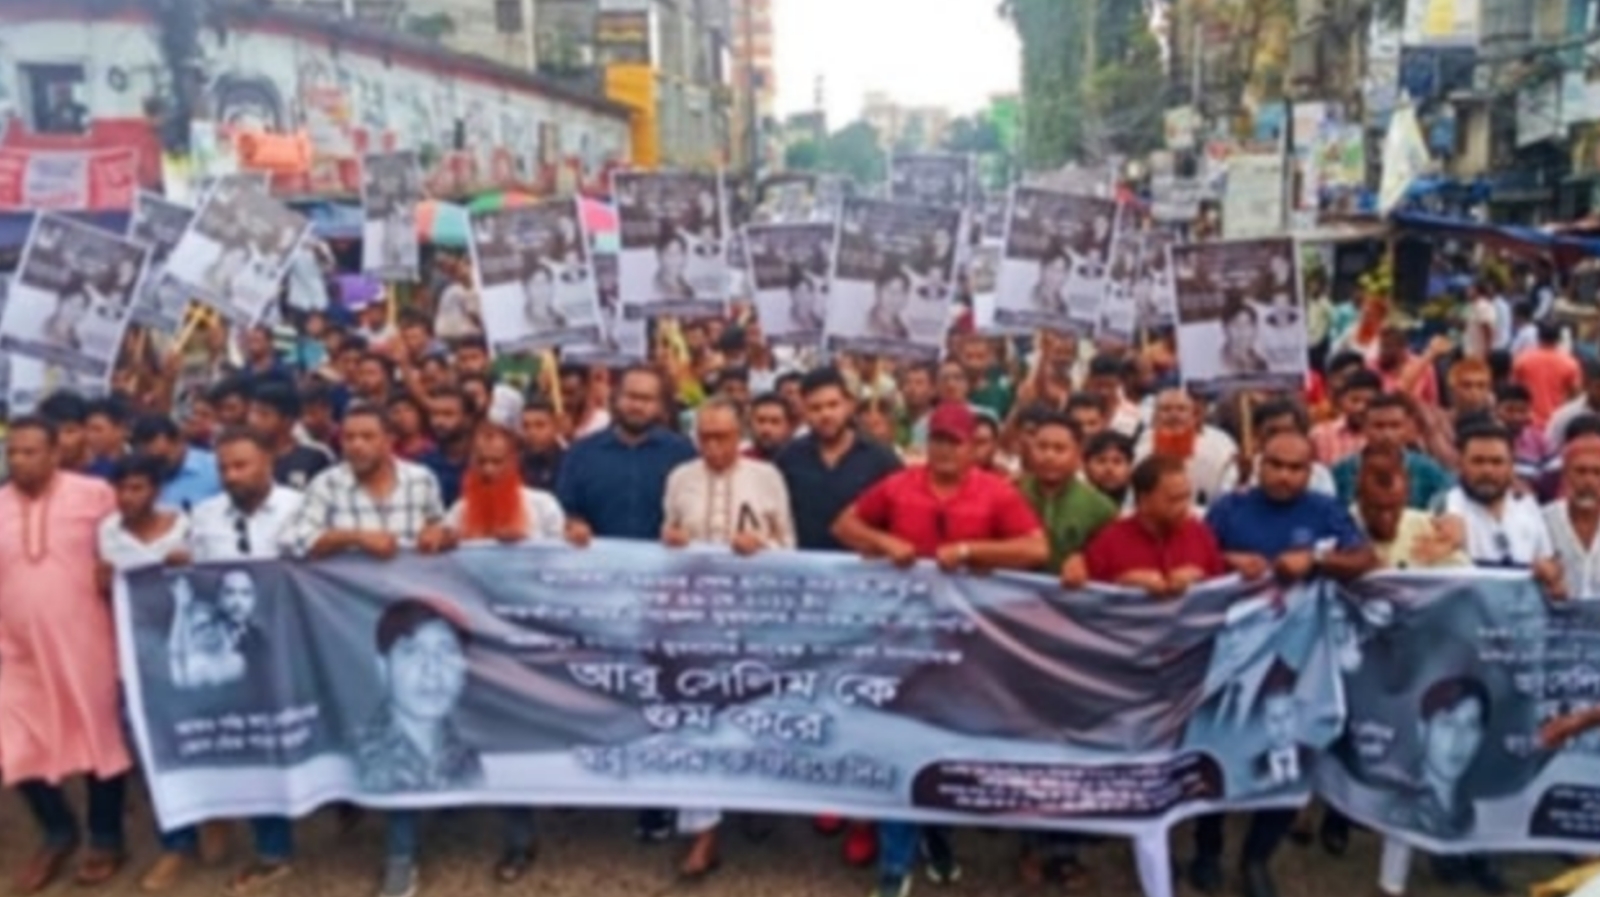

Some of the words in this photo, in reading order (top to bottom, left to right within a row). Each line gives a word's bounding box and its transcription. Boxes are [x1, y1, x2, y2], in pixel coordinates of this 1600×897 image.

[567, 661, 664, 700] আবু
[676, 659, 817, 699] সেলিম
[835, 673, 902, 706] কে
[727, 704, 824, 741] করে
